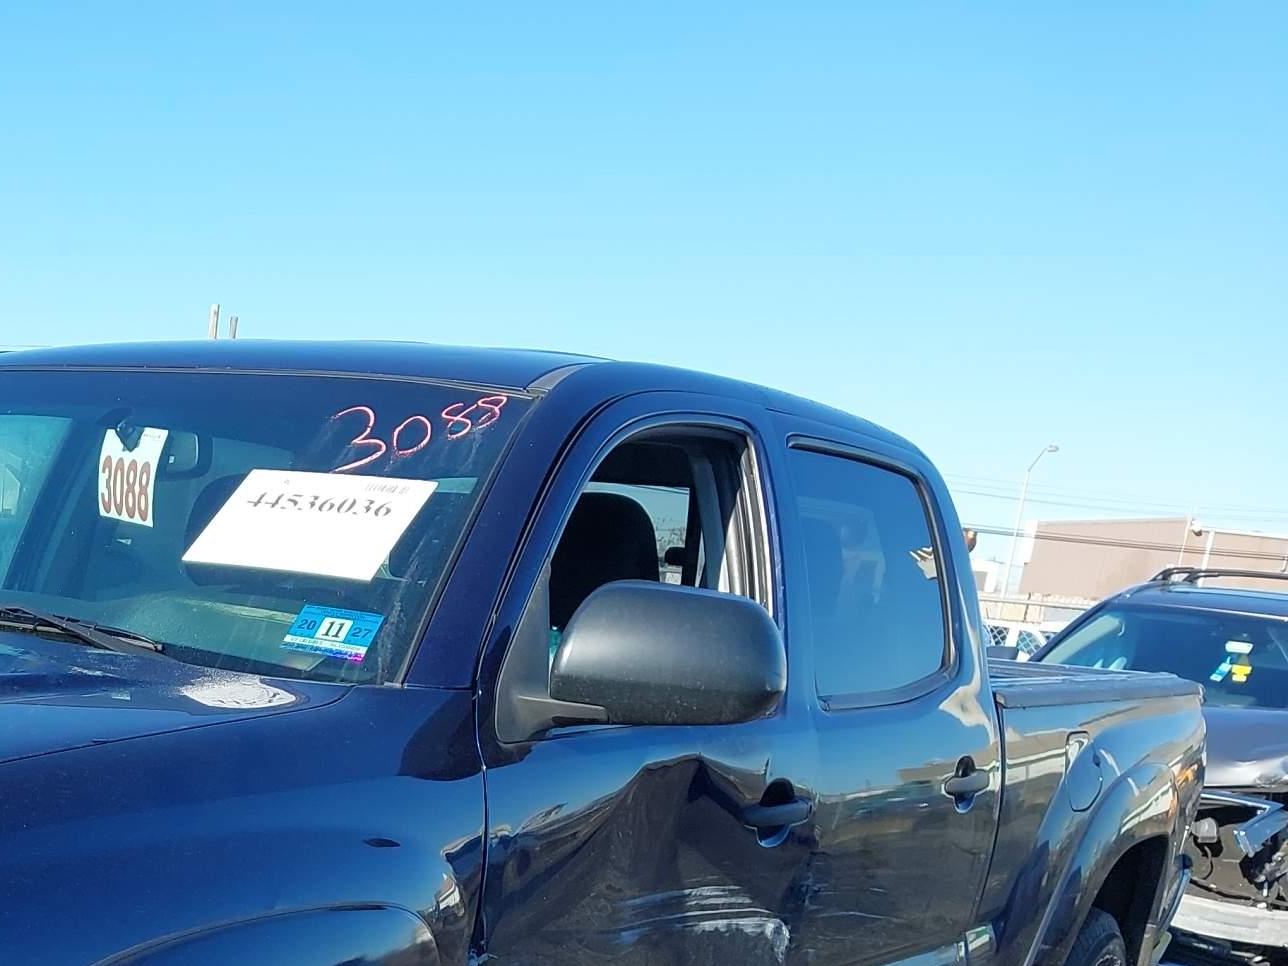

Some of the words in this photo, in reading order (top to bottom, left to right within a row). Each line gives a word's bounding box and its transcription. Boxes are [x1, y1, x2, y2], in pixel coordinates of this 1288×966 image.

[330, 395, 508, 474] 3088
[100, 454, 151, 522] 3088
[247, 491, 392, 518] 44536036
[296, 618, 317, 631] 20
[321, 620, 346, 638] 11
[351, 626, 373, 639] 27
